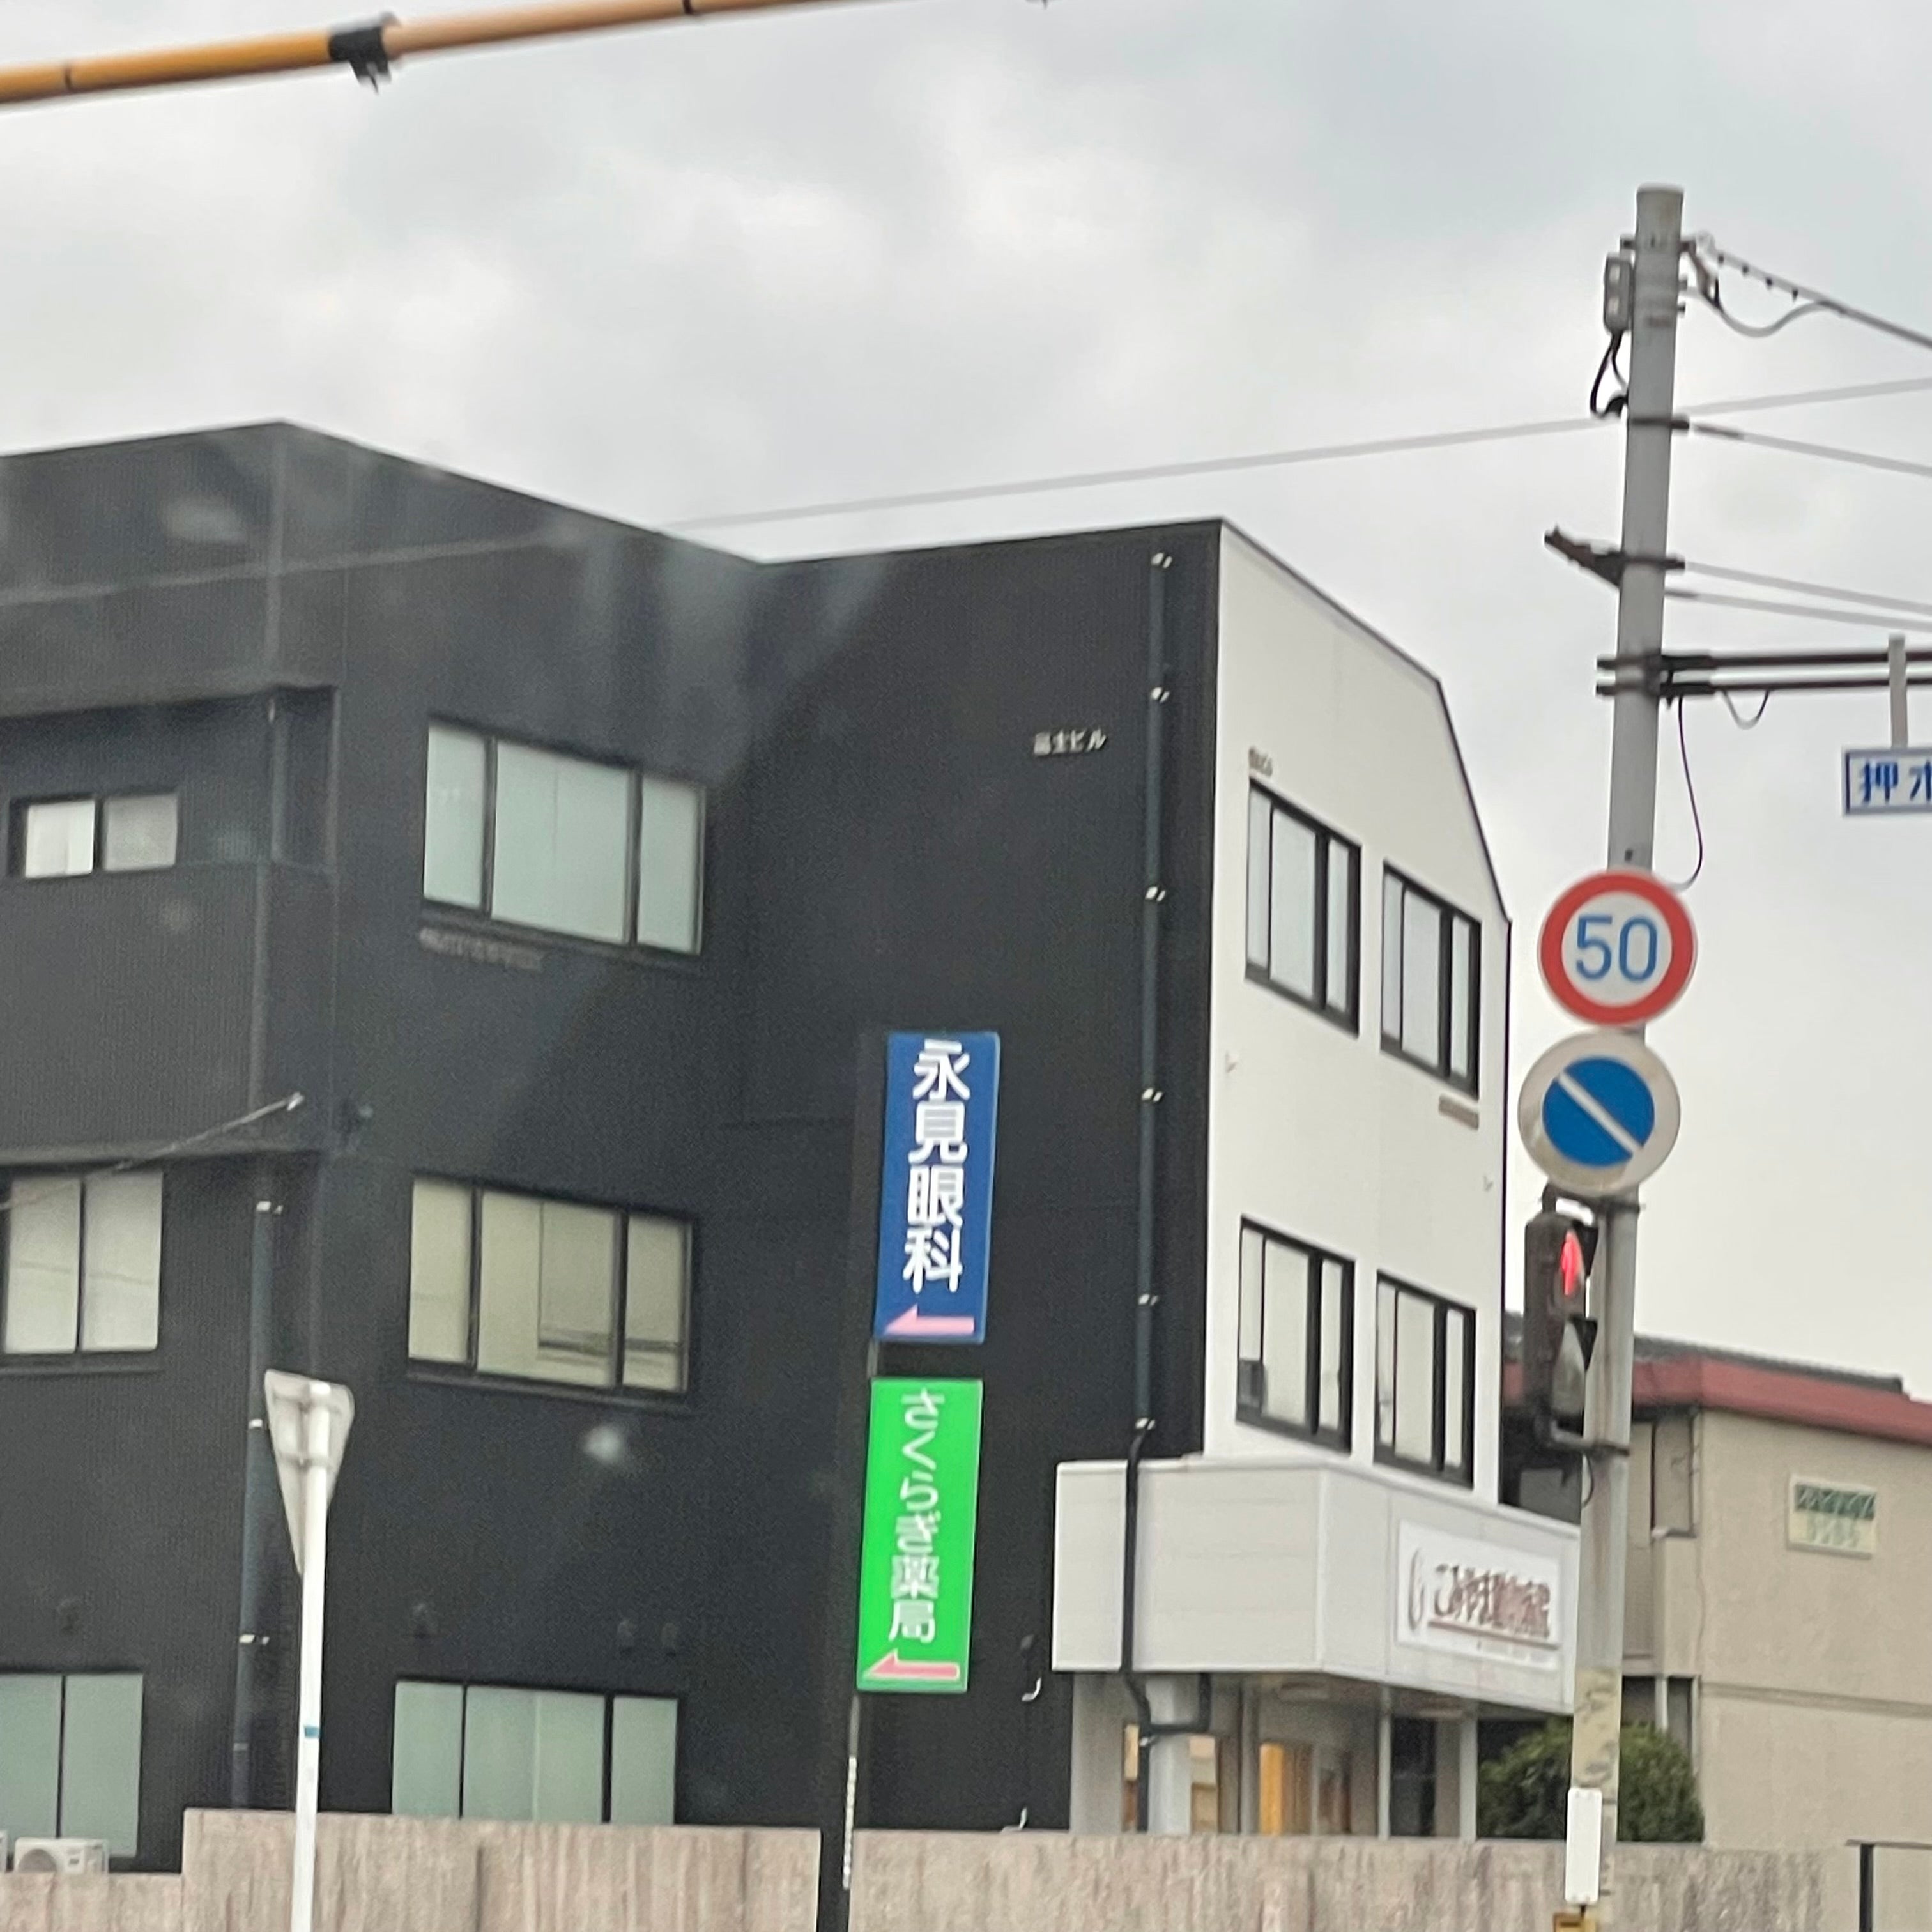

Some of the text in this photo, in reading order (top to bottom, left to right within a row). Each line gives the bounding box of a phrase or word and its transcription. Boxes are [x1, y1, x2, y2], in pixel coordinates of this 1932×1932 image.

[1575, 914, 1658, 983] 50
[902, 1038, 970, 1294] 永見眼科
[888, 1387, 946, 1644] さくらぎ薬局
